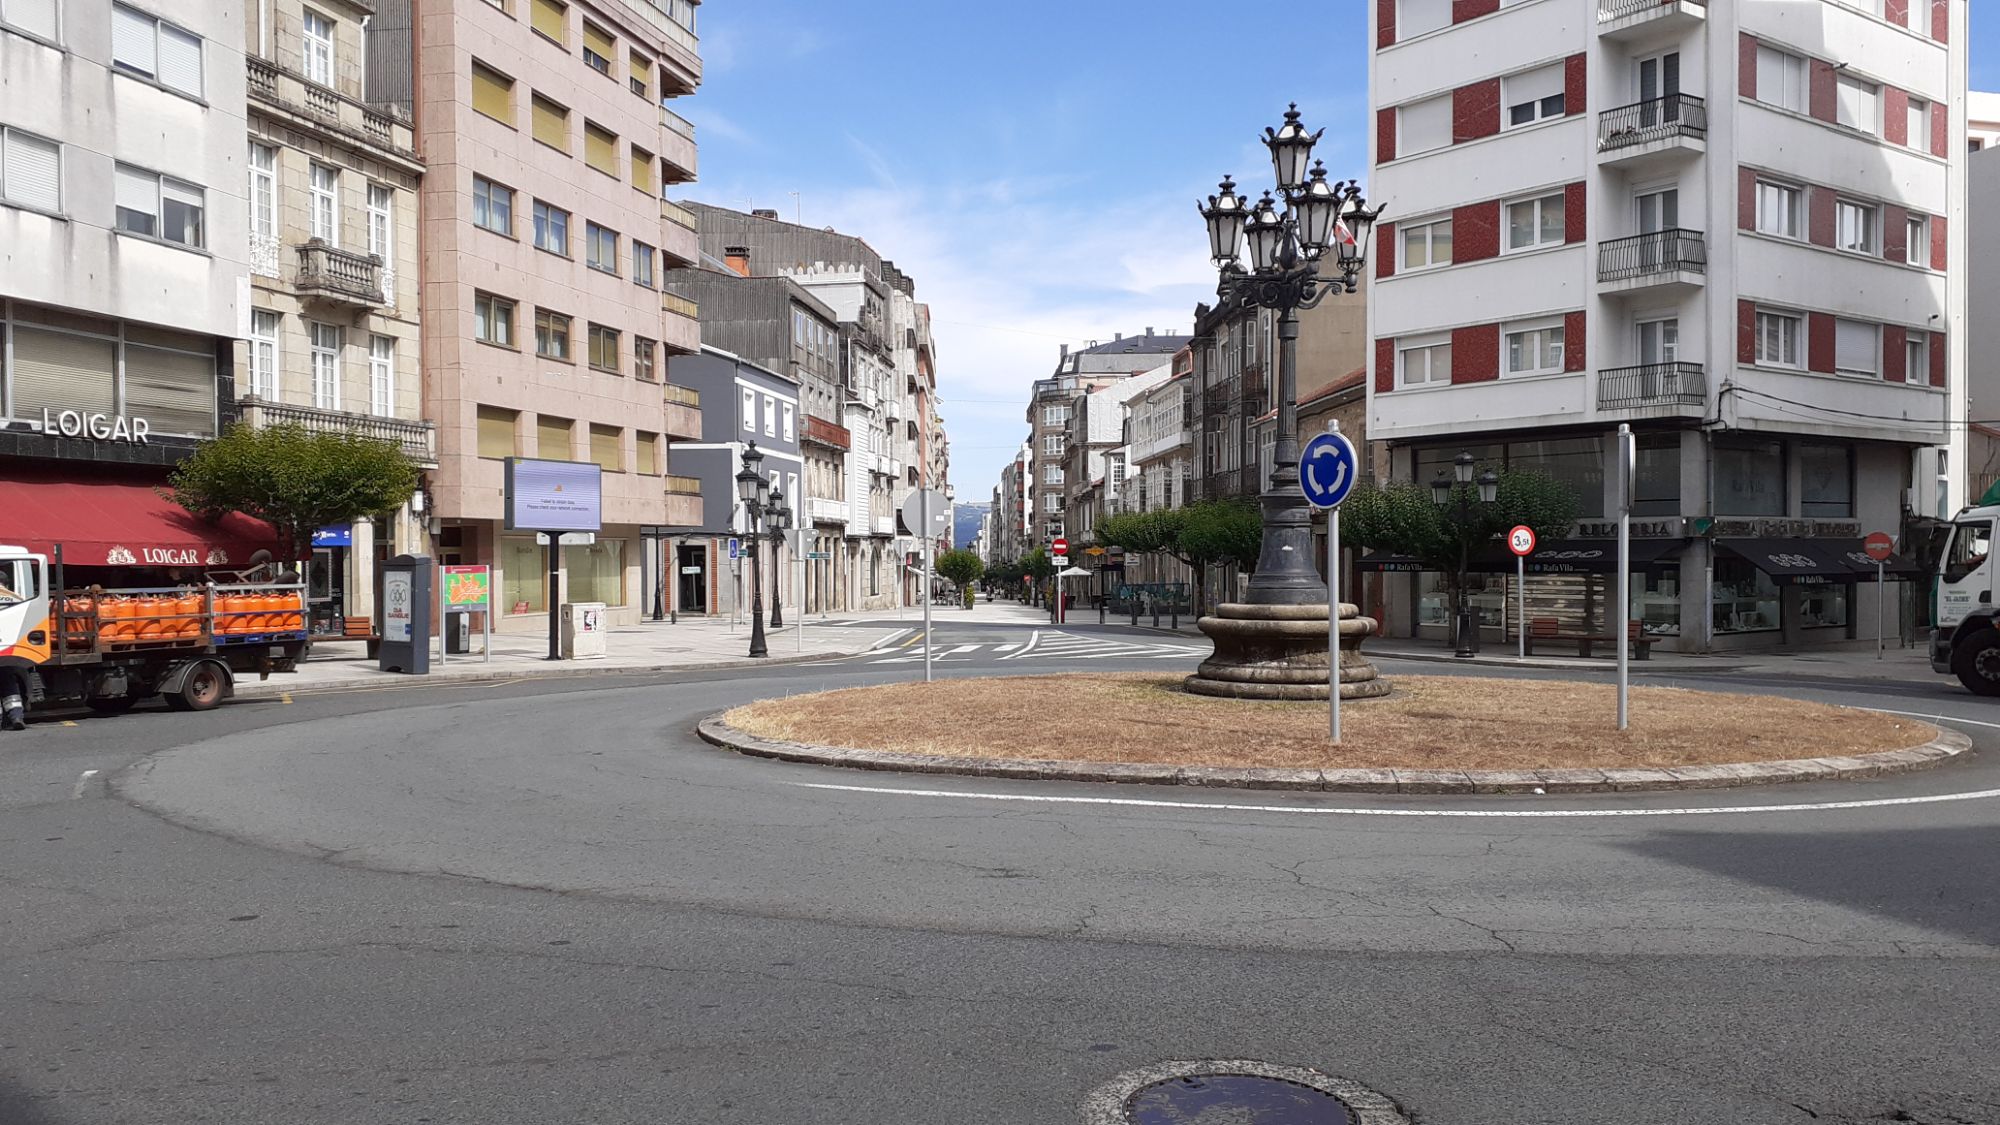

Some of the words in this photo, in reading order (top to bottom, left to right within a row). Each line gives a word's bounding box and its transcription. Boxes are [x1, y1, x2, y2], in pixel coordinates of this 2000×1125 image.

[42, 407, 149, 444] LOIGAR
[1579, 521, 1670, 536] RELOERIA
[143, 548, 199, 565] LOIGAR
[1543, 563, 1559, 572] Rafa
[1559, 563, 1574, 572] Vila
